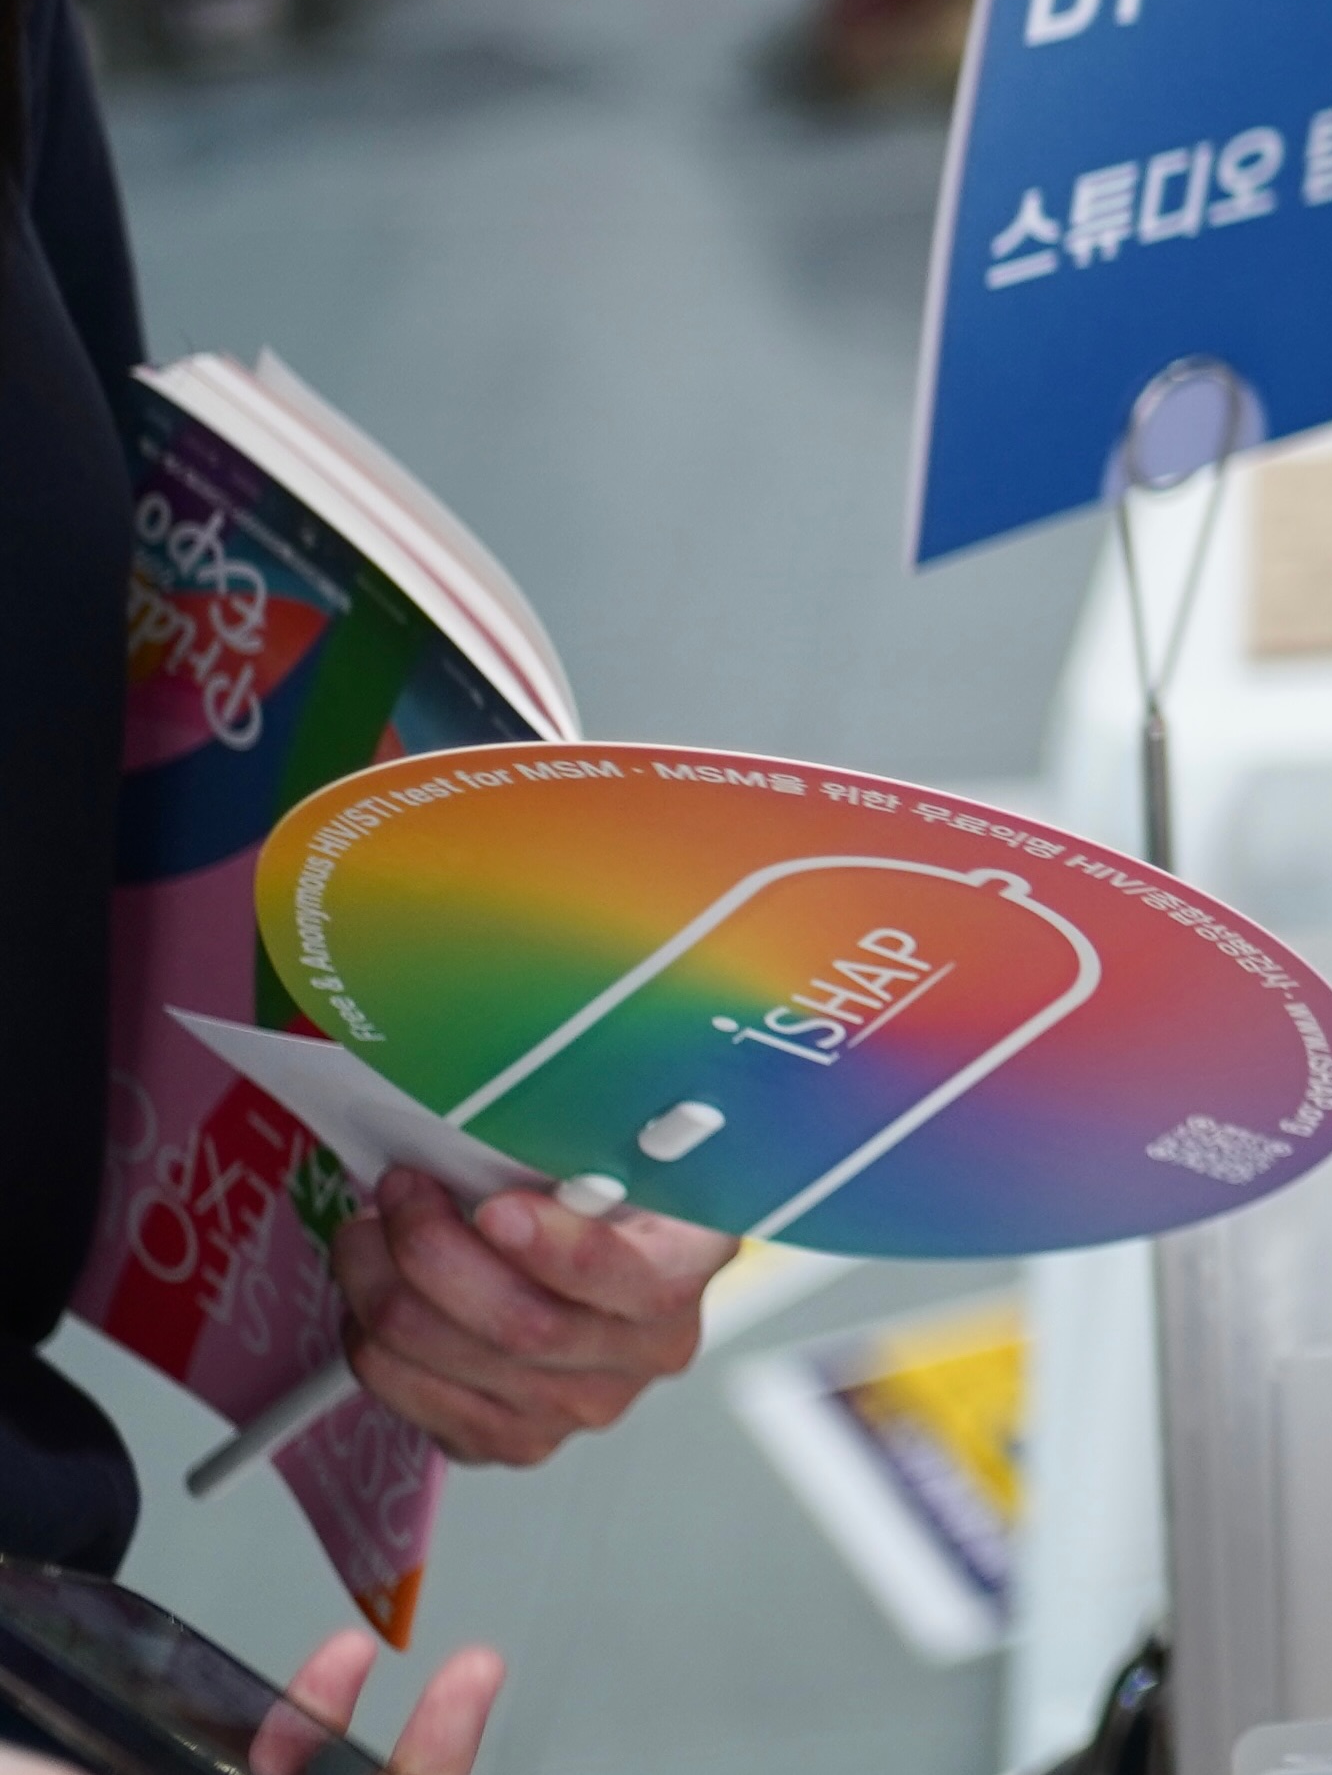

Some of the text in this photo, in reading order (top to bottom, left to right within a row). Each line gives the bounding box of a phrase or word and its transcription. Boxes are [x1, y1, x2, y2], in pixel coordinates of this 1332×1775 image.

[985, 124, 1286, 290] 스튜디오
[128, 580, 264, 752] Prid
[650, 760, 808, 796] MSM을
[818, 781, 903, 814] 위한
[910, 802, 1067, 860] 무료익명
[294, 759, 626, 1043] Free & Anonymous HIV/STI test for MSM
[711, 926, 933, 1066] iSHAP
